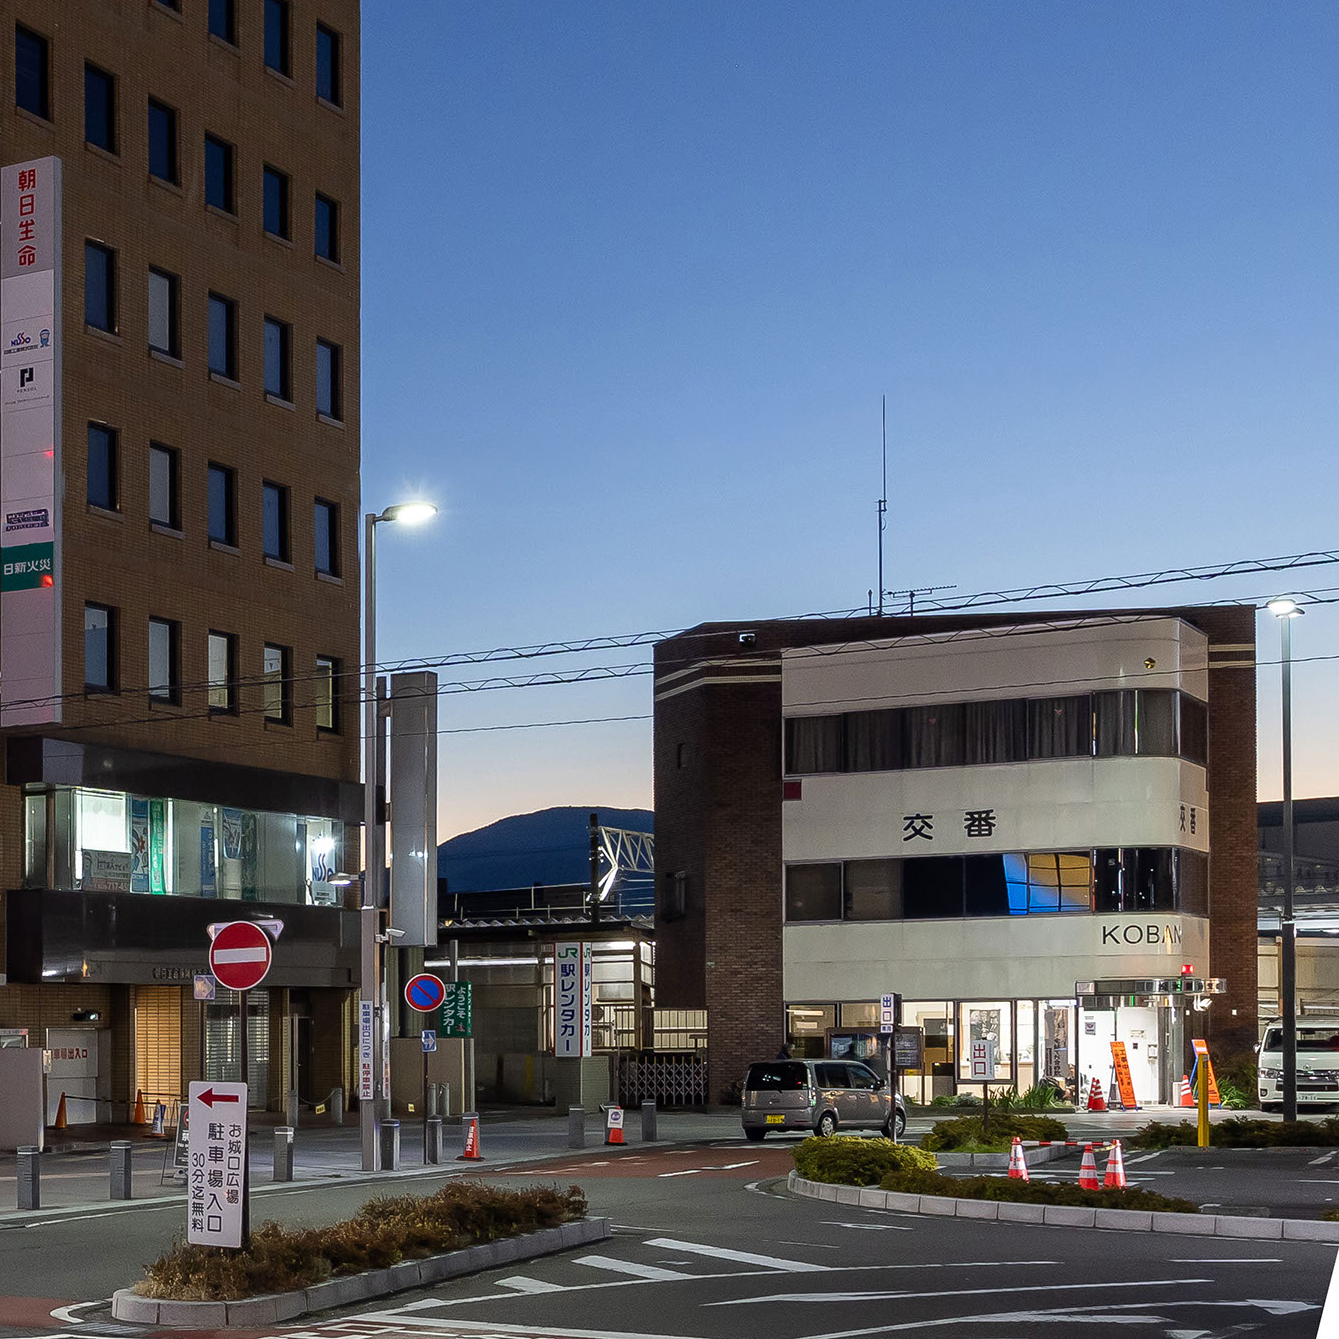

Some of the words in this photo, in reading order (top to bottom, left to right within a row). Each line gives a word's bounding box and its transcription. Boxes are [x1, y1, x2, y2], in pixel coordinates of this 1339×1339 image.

[17, 168, 37, 267] 朝日生命
[3, 558, 51, 575] 日新火災
[903, 809, 997, 842] 交番
[1179, 804, 1196, 835] 交番
[1102, 924, 1182, 945] KOBAN
[558, 947, 578, 959] JR
[457, 986, 467, 1019] ようこそ
[561, 963, 575, 1052] 駅レンタカー
[882, 995, 892, 1022] 出口
[973, 1043, 986, 1076] 出口
[207, 1123, 224, 1233] 駐車場入口
[226, 1123, 242, 1205] お城口広場
[191, 1152, 205, 1233] 30分迄無料
